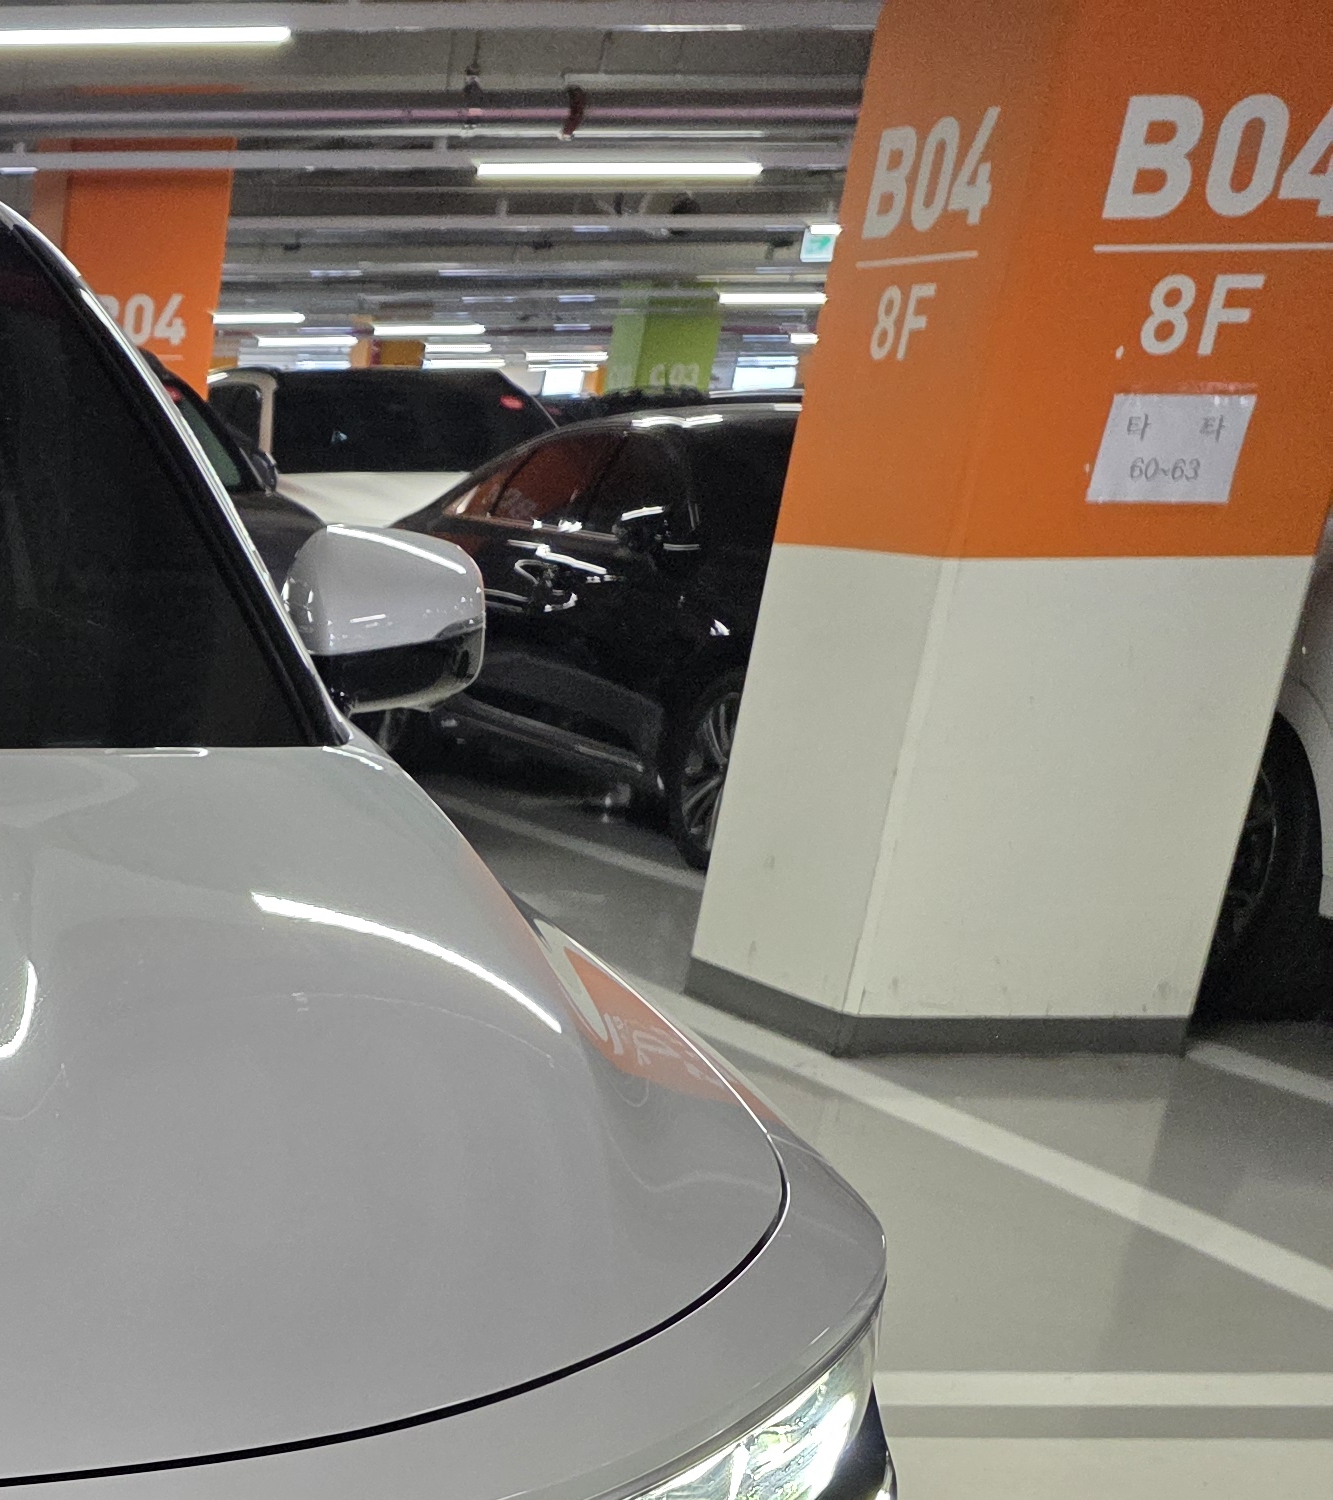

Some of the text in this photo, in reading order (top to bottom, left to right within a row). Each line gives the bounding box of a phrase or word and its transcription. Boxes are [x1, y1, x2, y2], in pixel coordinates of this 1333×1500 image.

[862, 106, 1001, 240] B04
[869, 282, 937, 361] 8F
[1140, 273, 1266, 357] 8F
